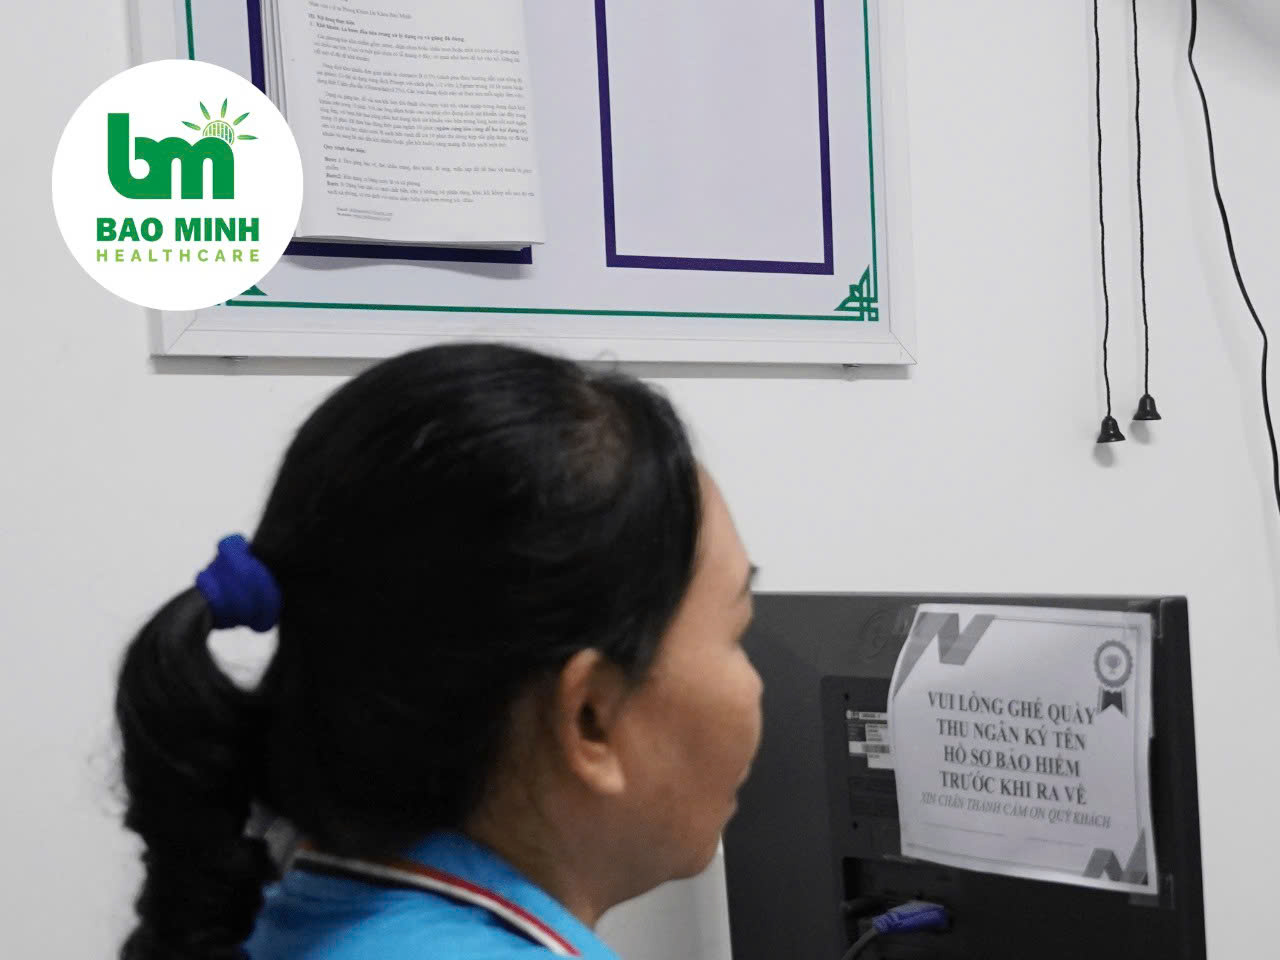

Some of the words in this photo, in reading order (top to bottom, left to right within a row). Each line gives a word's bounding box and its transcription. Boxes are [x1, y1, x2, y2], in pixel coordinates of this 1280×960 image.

[928, 691, 955, 710] VUI
[937, 718, 968, 738] THU
[1000, 778, 1031, 797] KHI
[1038, 784, 1060, 801] RA
